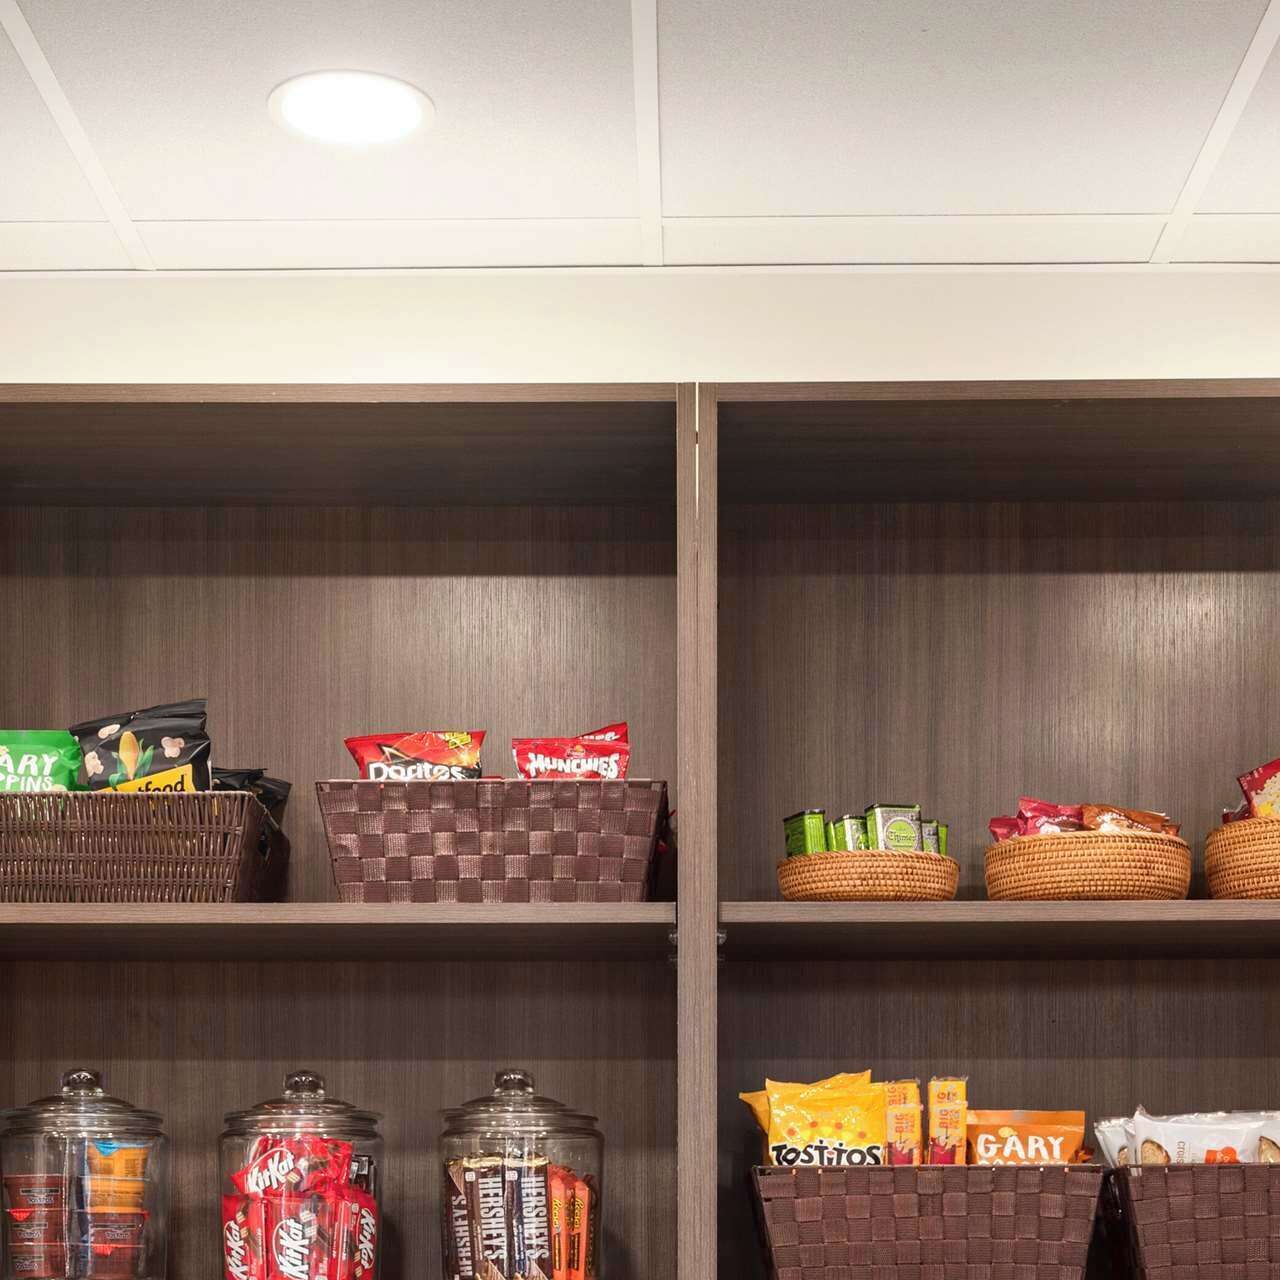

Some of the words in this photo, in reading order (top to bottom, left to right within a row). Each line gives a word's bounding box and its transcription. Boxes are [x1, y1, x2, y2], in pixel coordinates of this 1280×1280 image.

[368, 763, 462, 781] Doritos
[528, 752, 620, 778] MUNCHIES
[248, 1151, 296, 1192] KitKat
[977, 1133, 1066, 1159] GARY
[451, 1194, 472, 1276] HERSHEY'S
[478, 1176, 507, 1261] HERSHEY'S
[521, 1176, 550, 1260] HERSHEY'S
[226, 1220, 248, 1280] KitKat
[279, 1218, 310, 1280] KitKat
